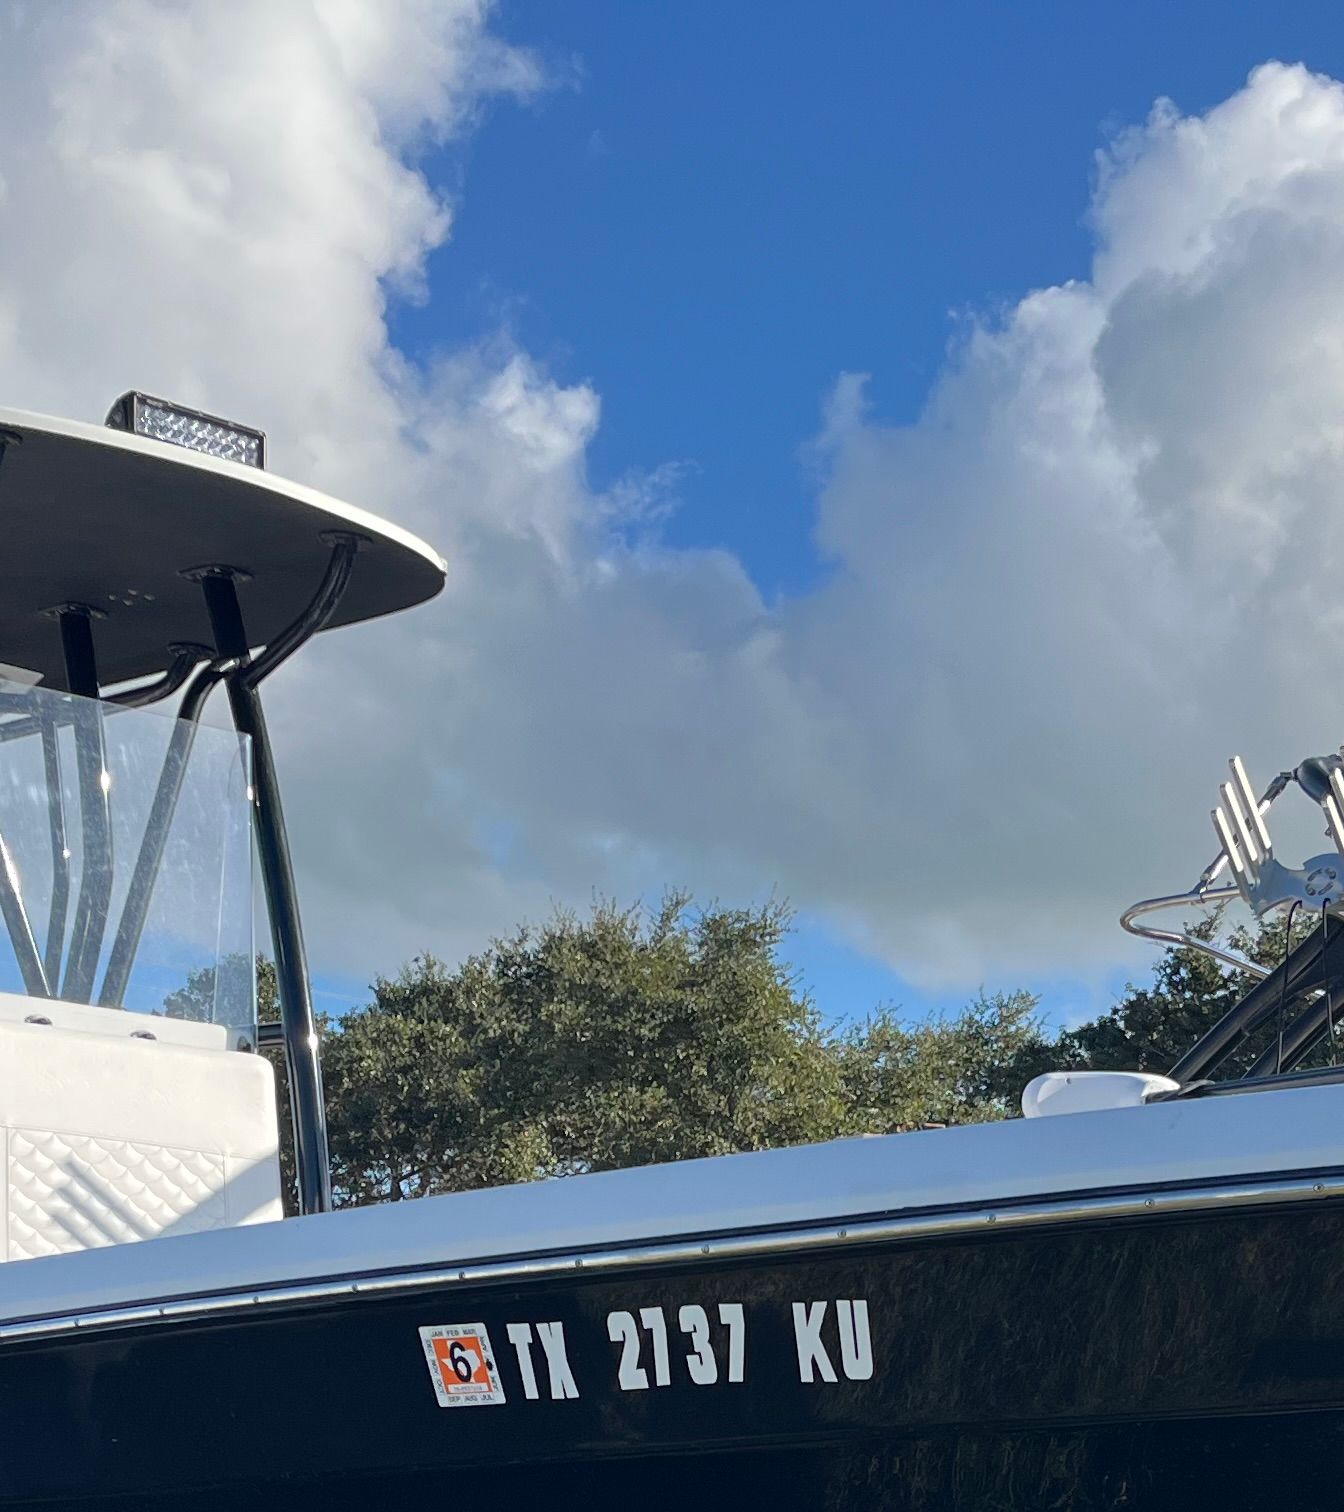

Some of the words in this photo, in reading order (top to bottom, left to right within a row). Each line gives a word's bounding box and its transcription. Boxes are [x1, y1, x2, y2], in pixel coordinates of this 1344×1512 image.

[449, 1341, 472, 1383] 6
[506, 1321, 579, 1400] TX
[792, 1299, 874, 1384] KU
